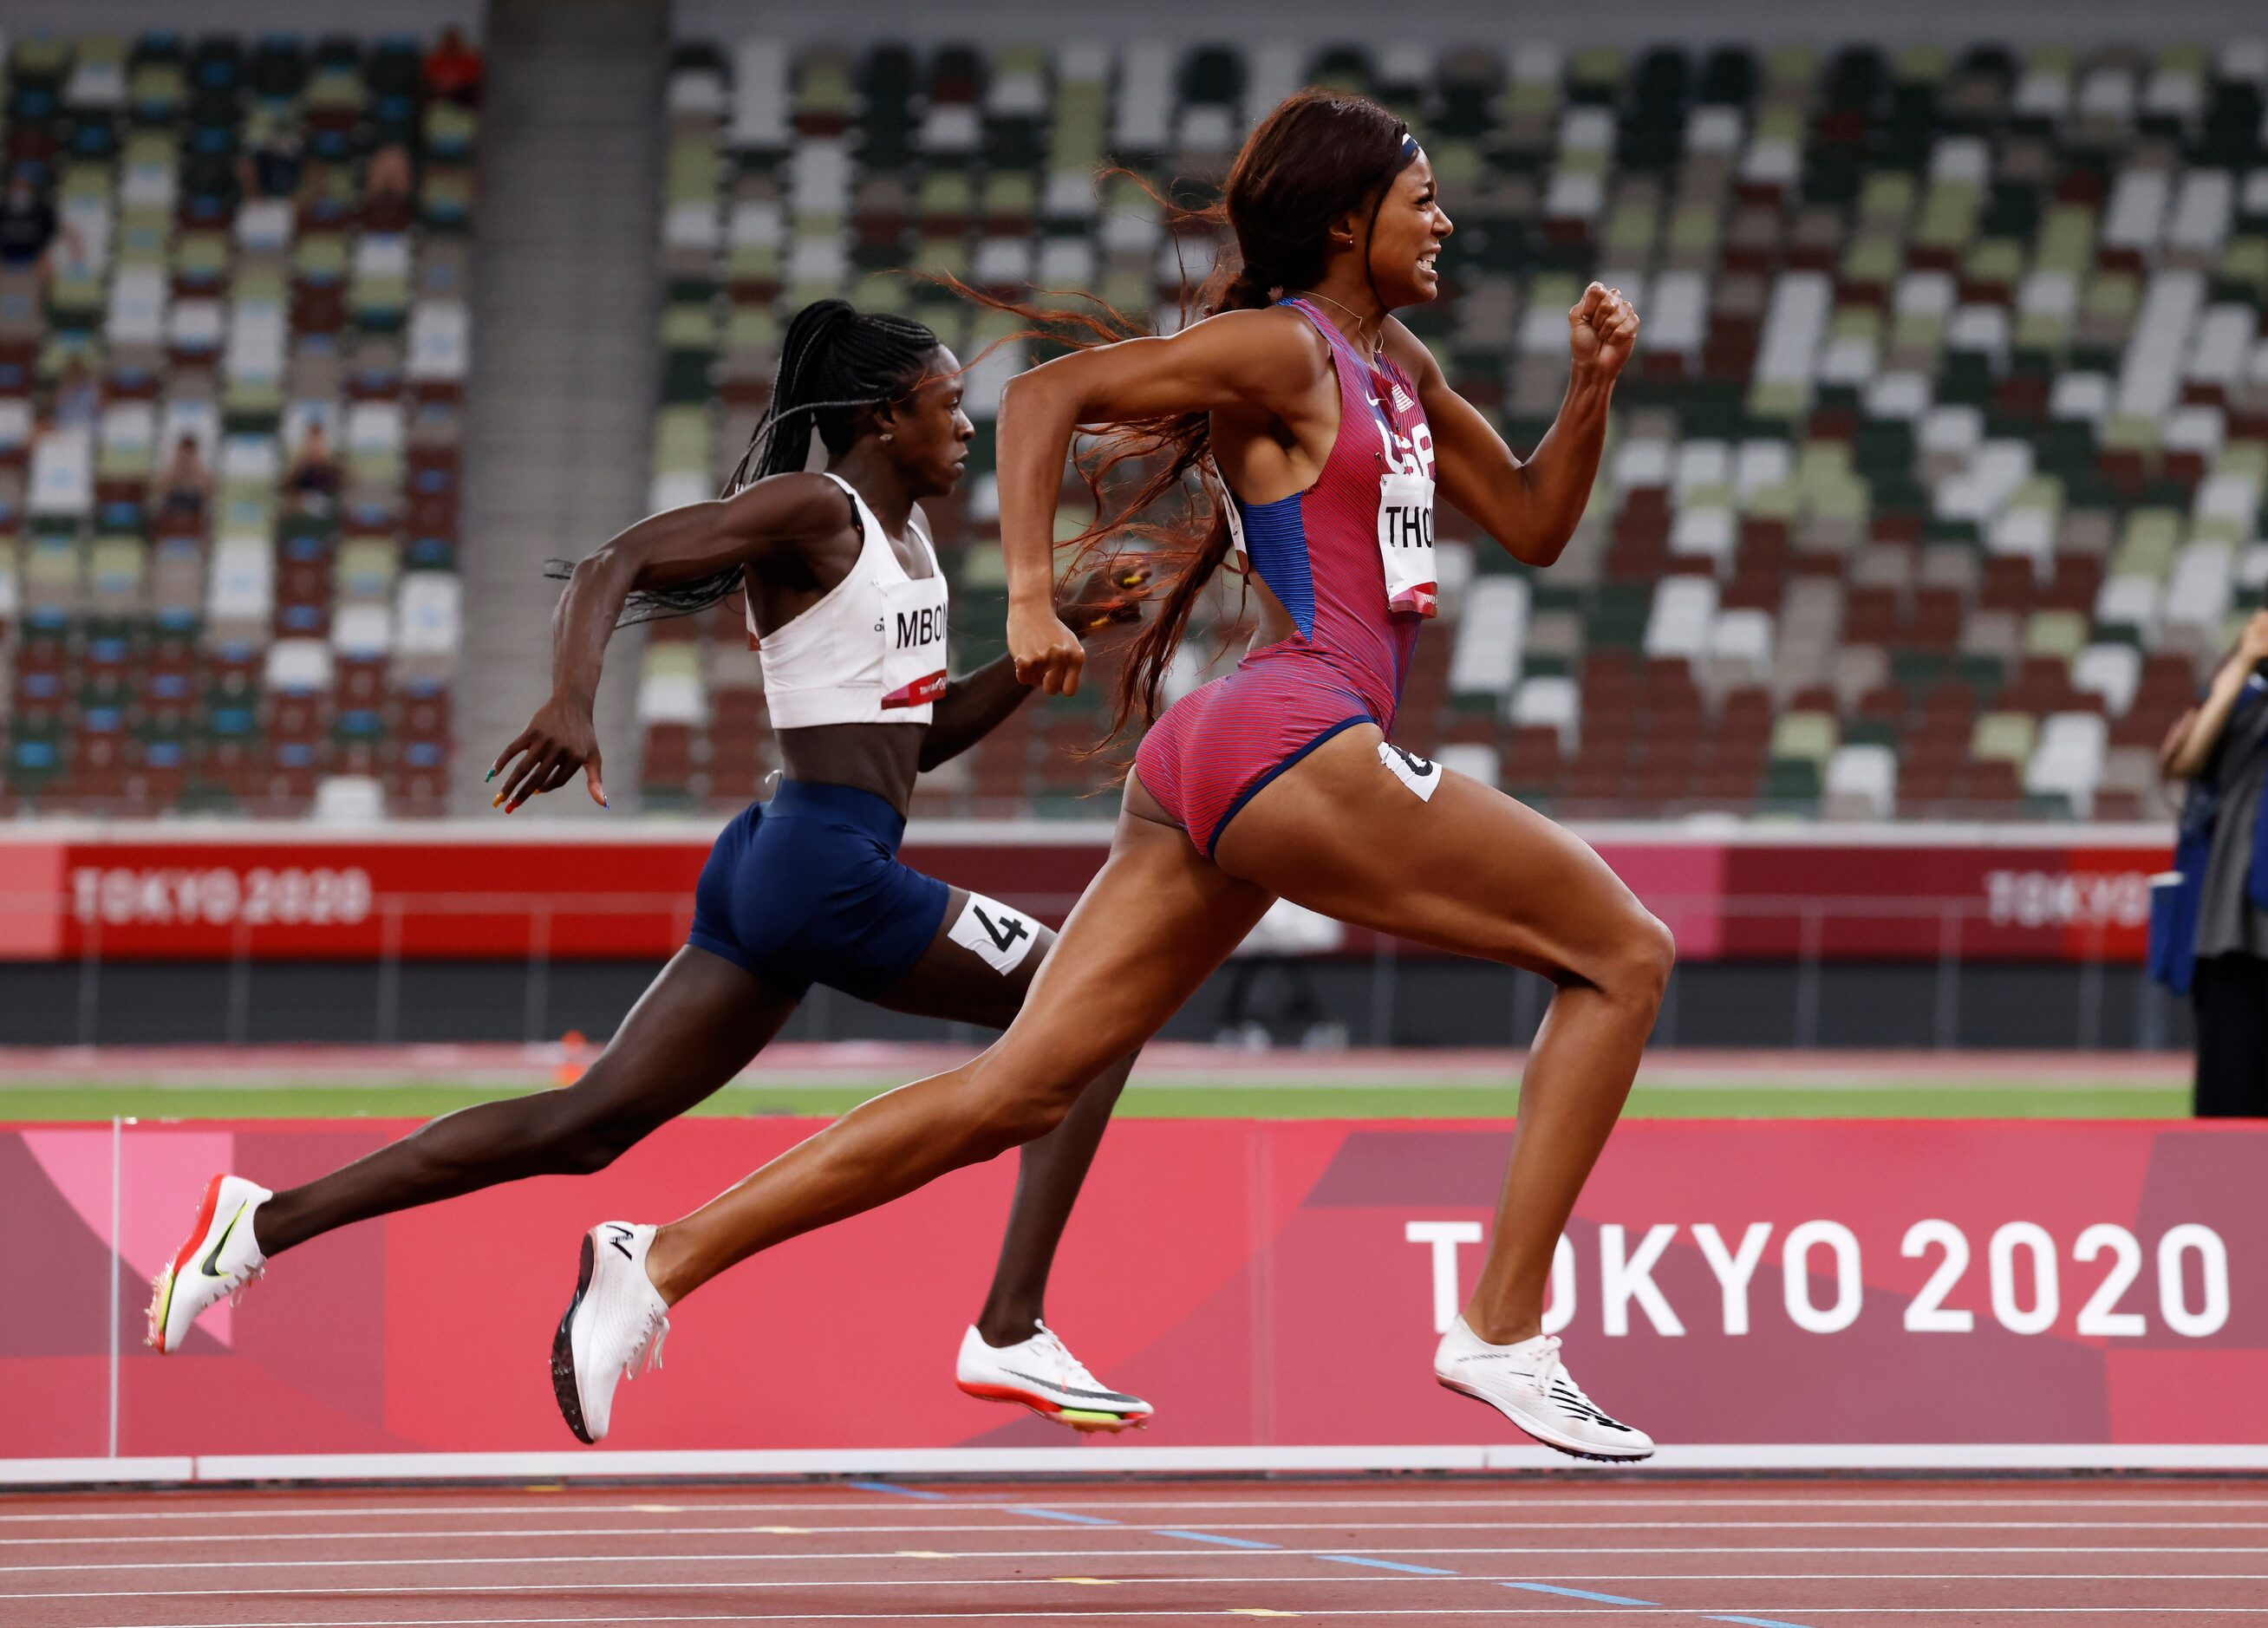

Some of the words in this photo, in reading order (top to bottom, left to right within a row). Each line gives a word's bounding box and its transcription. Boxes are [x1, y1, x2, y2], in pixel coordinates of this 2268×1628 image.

[73, 867, 241, 925] TOKYO
[243, 867, 371, 925] 2020
[973, 904, 1029, 954] 4
[1901, 1219, 2229, 1337] 2020
